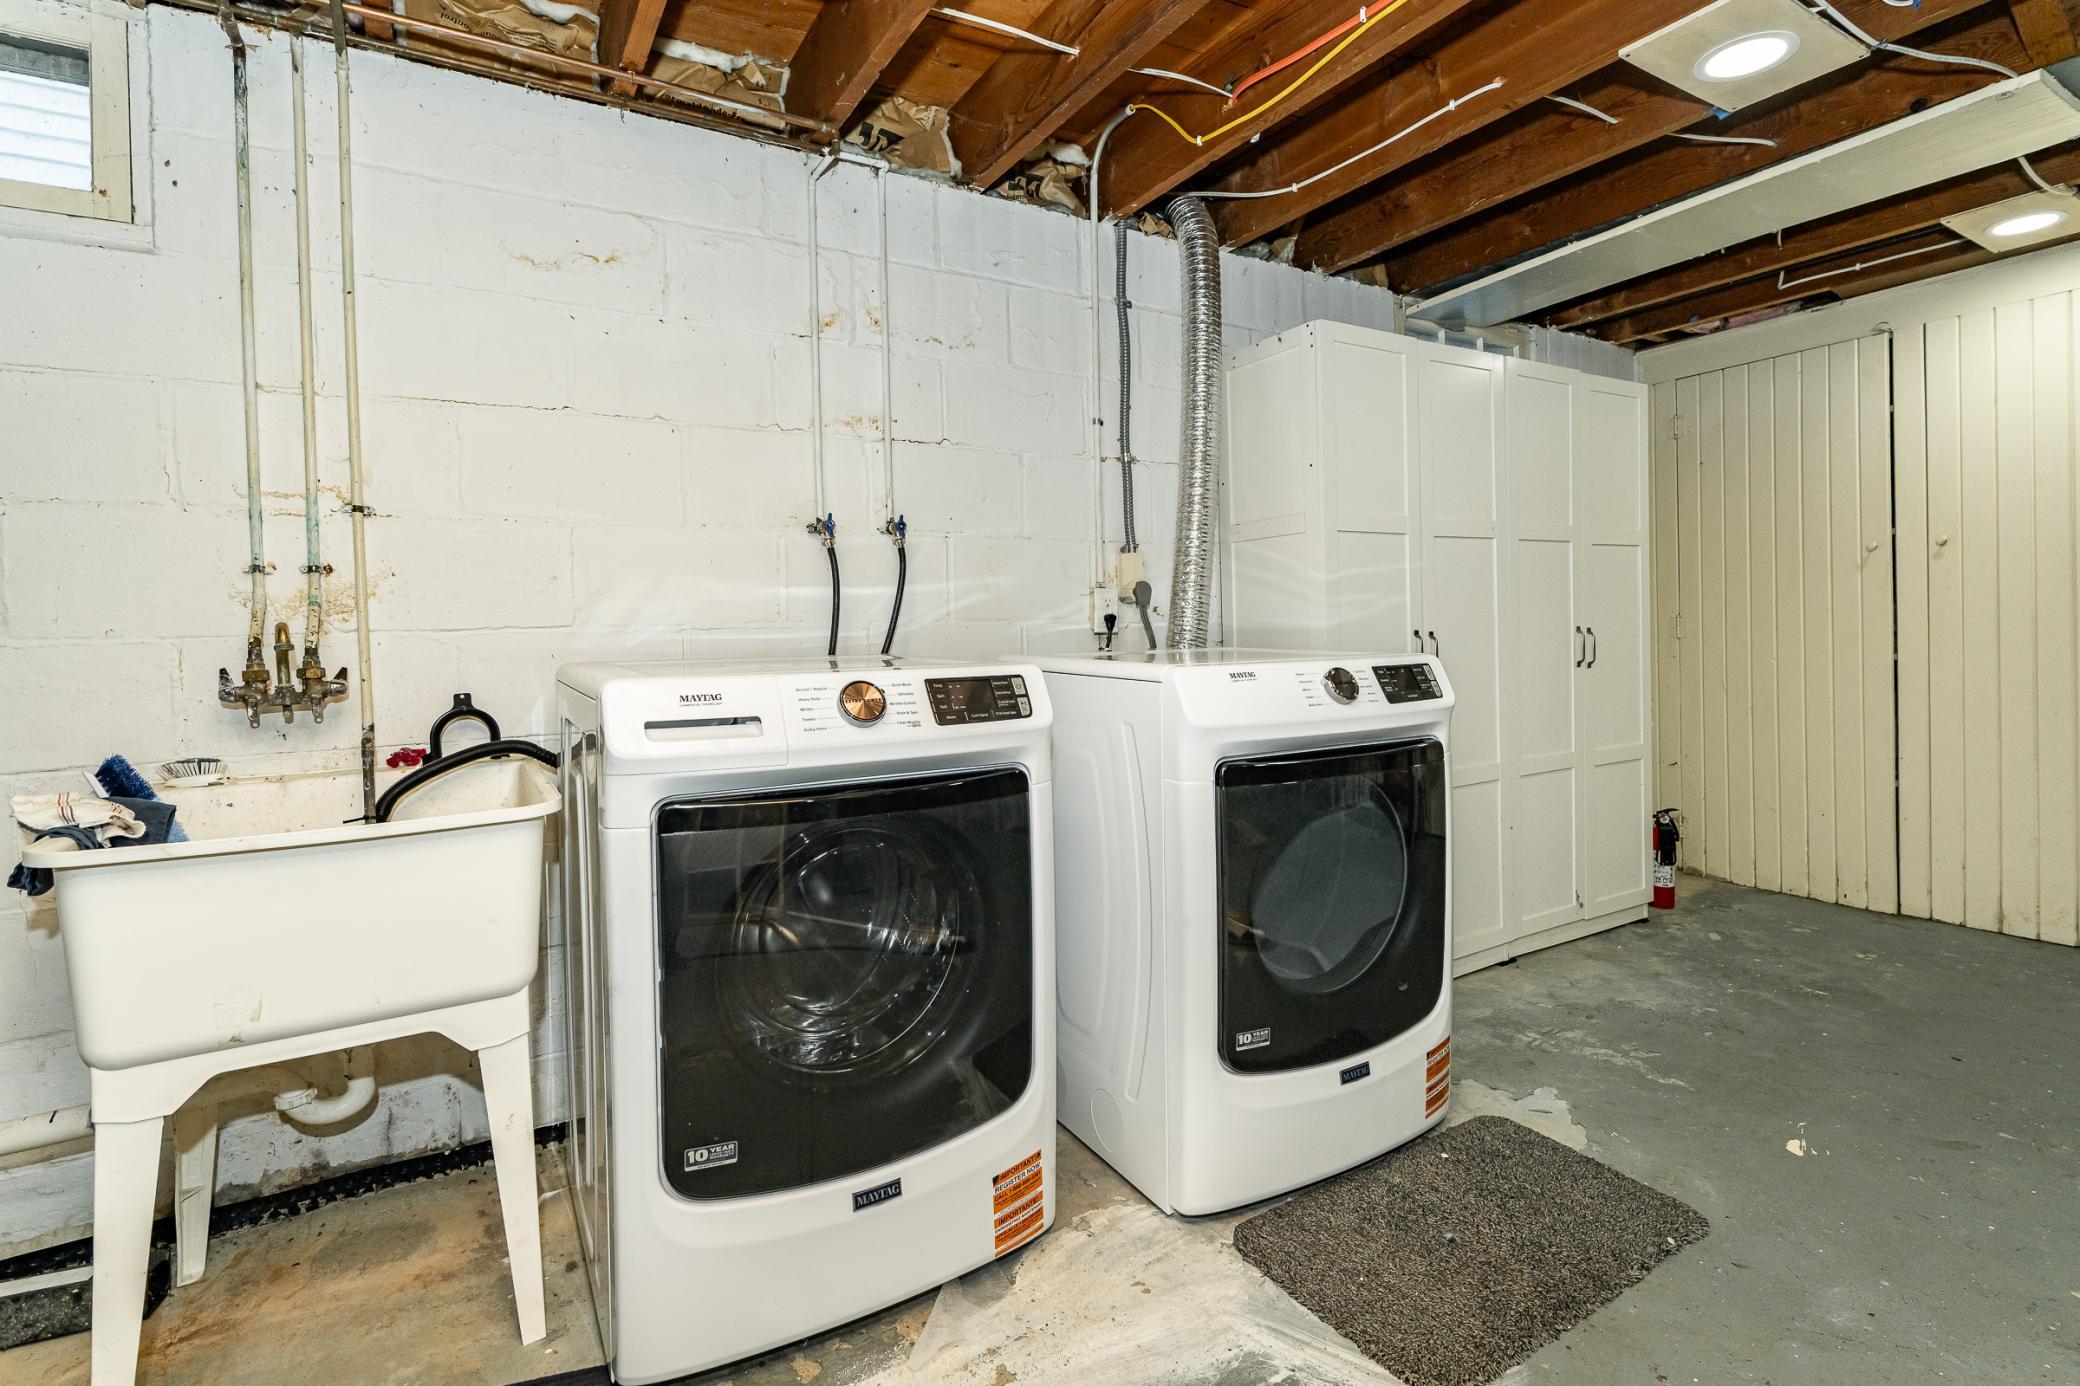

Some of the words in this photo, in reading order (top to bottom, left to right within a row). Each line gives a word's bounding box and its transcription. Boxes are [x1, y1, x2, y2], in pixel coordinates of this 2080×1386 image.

[1229, 671, 1256, 679] MAYTAG
[679, 693, 722, 702] MAYTAG
[1238, 1034, 1252, 1045] 10
[1252, 1029, 1269, 1037] YEAR
[1343, 1067, 1369, 1080] MAYTAG
[688, 1149, 708, 1164] 10
[710, 1144, 735, 1153] YEAR
[994, 1172, 1026, 1194] REGISTER
[1026, 1162, 1040, 1175] NOW
[857, 1184, 899, 1207] MAYTAG
[994, 1191, 1008, 1202] CALL
